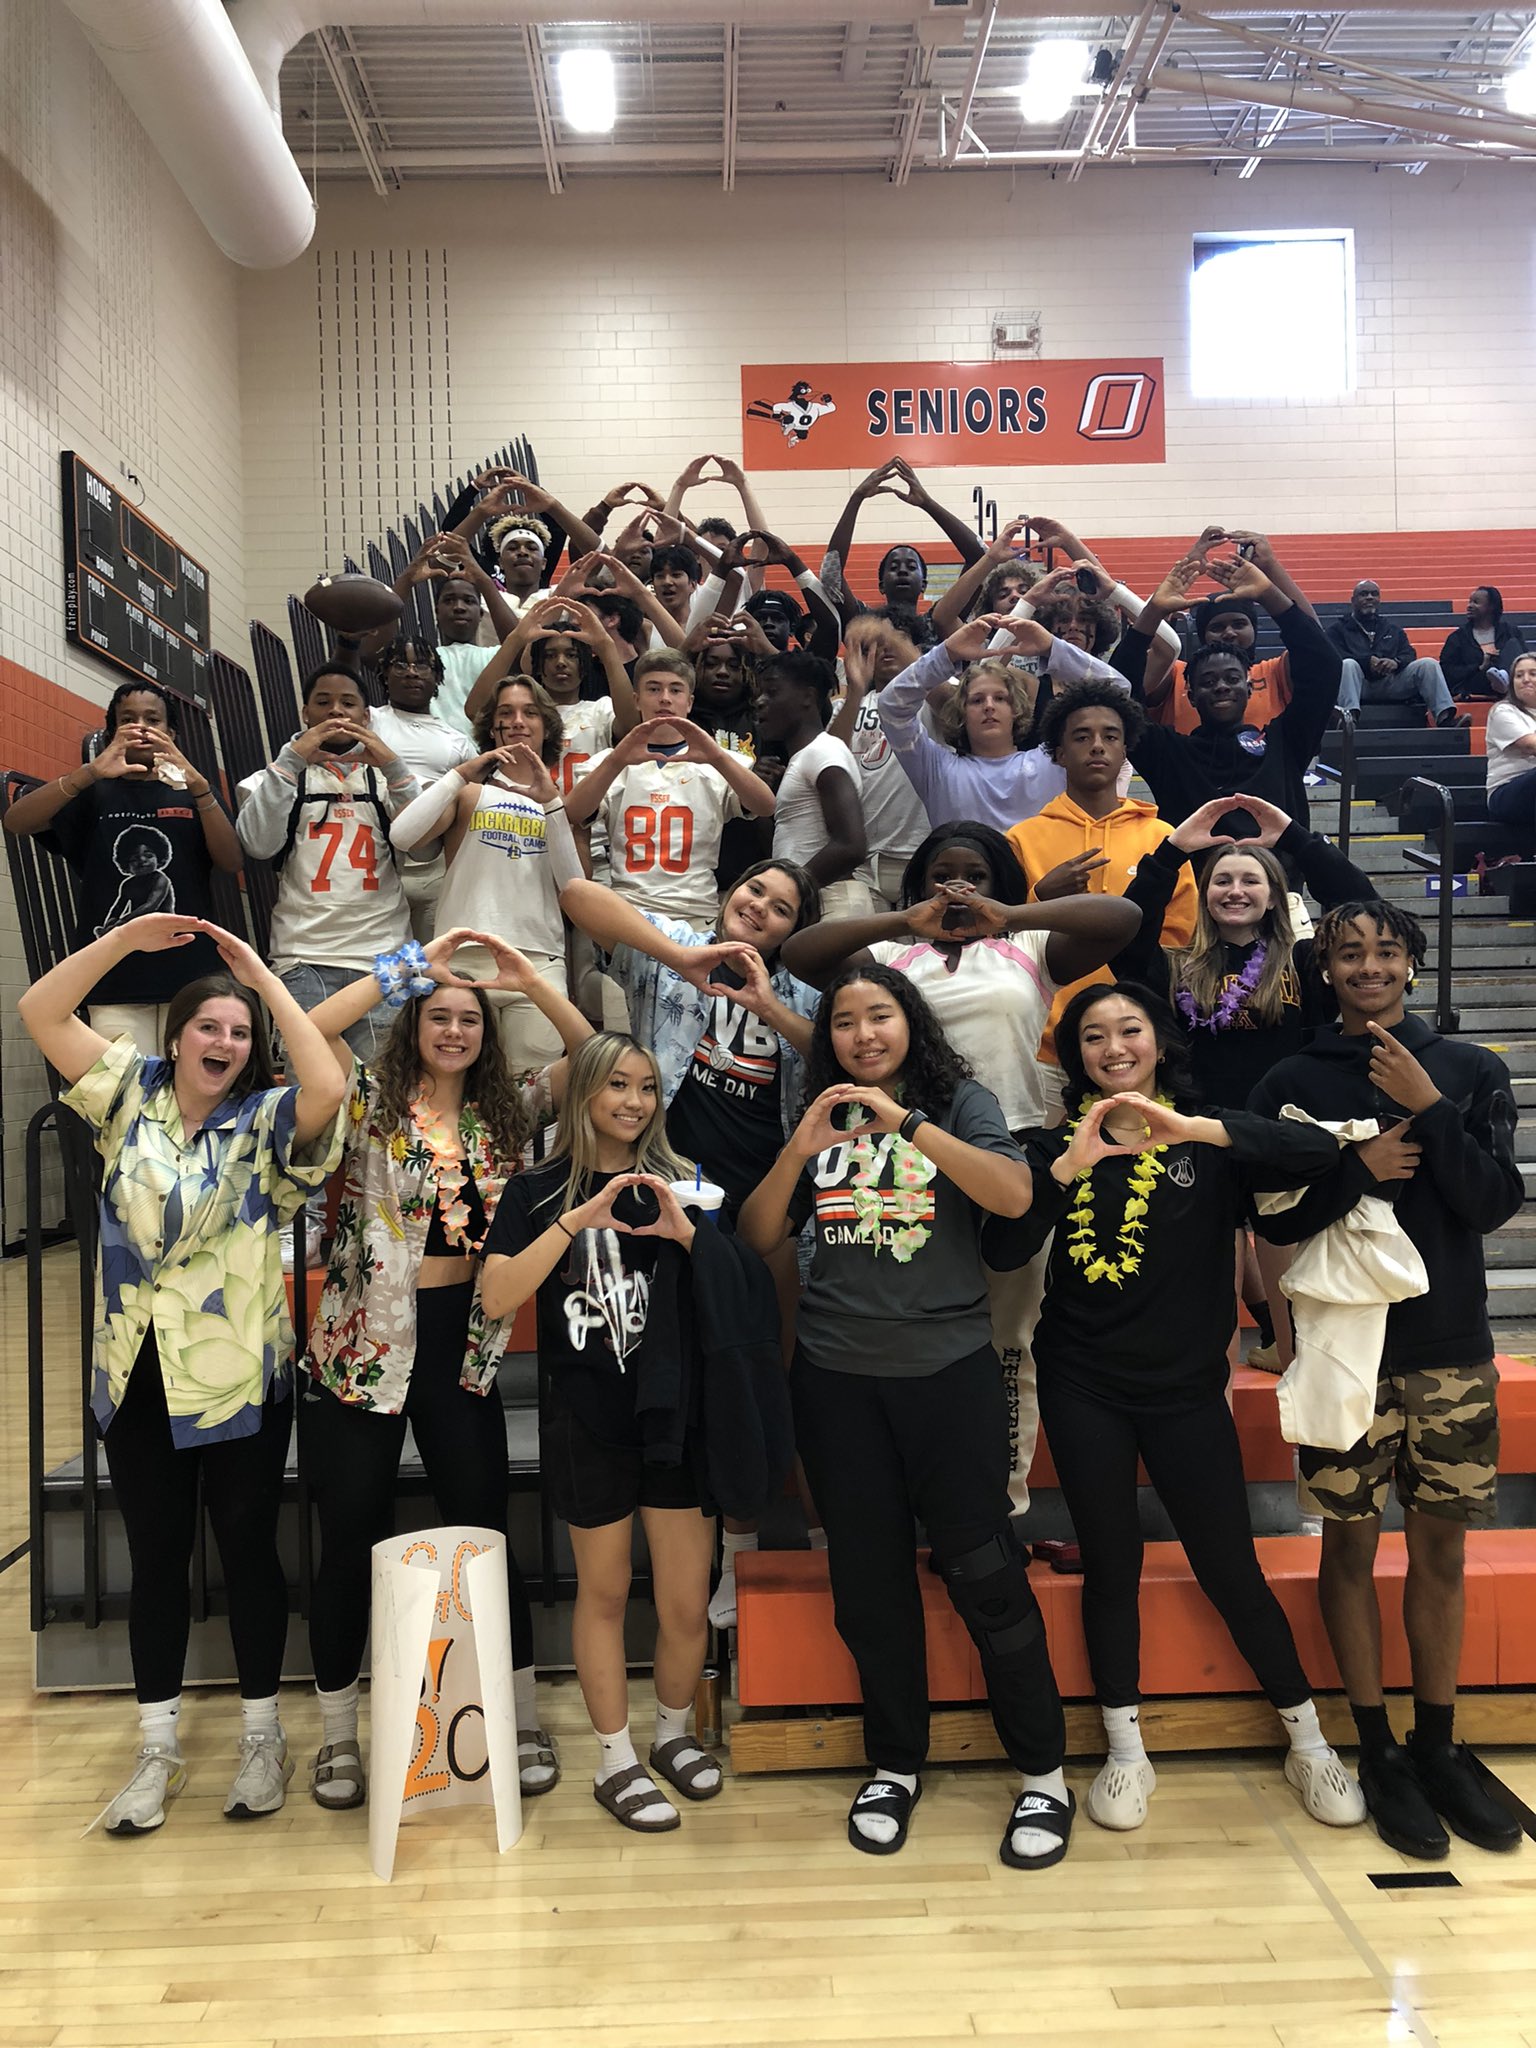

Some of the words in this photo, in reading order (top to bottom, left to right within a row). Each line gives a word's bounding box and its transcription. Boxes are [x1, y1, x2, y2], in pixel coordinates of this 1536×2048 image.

[866, 385, 1048, 437] SENIORS
[86, 471, 112, 512] HOME
[1240, 739, 1267, 751] NASA
[469, 810, 547, 839] JACKRABBI
[523, 837, 547, 849] CAMP
[624, 805, 694, 873] 80
[309, 821, 379, 892] 74
[715, 995, 779, 1058] VB
[692, 1063, 720, 1088] ME
[723, 1078, 758, 1100] DAY
[864, 1784, 893, 1796] NIKE
[1021, 1796, 1052, 1810] NIKE
